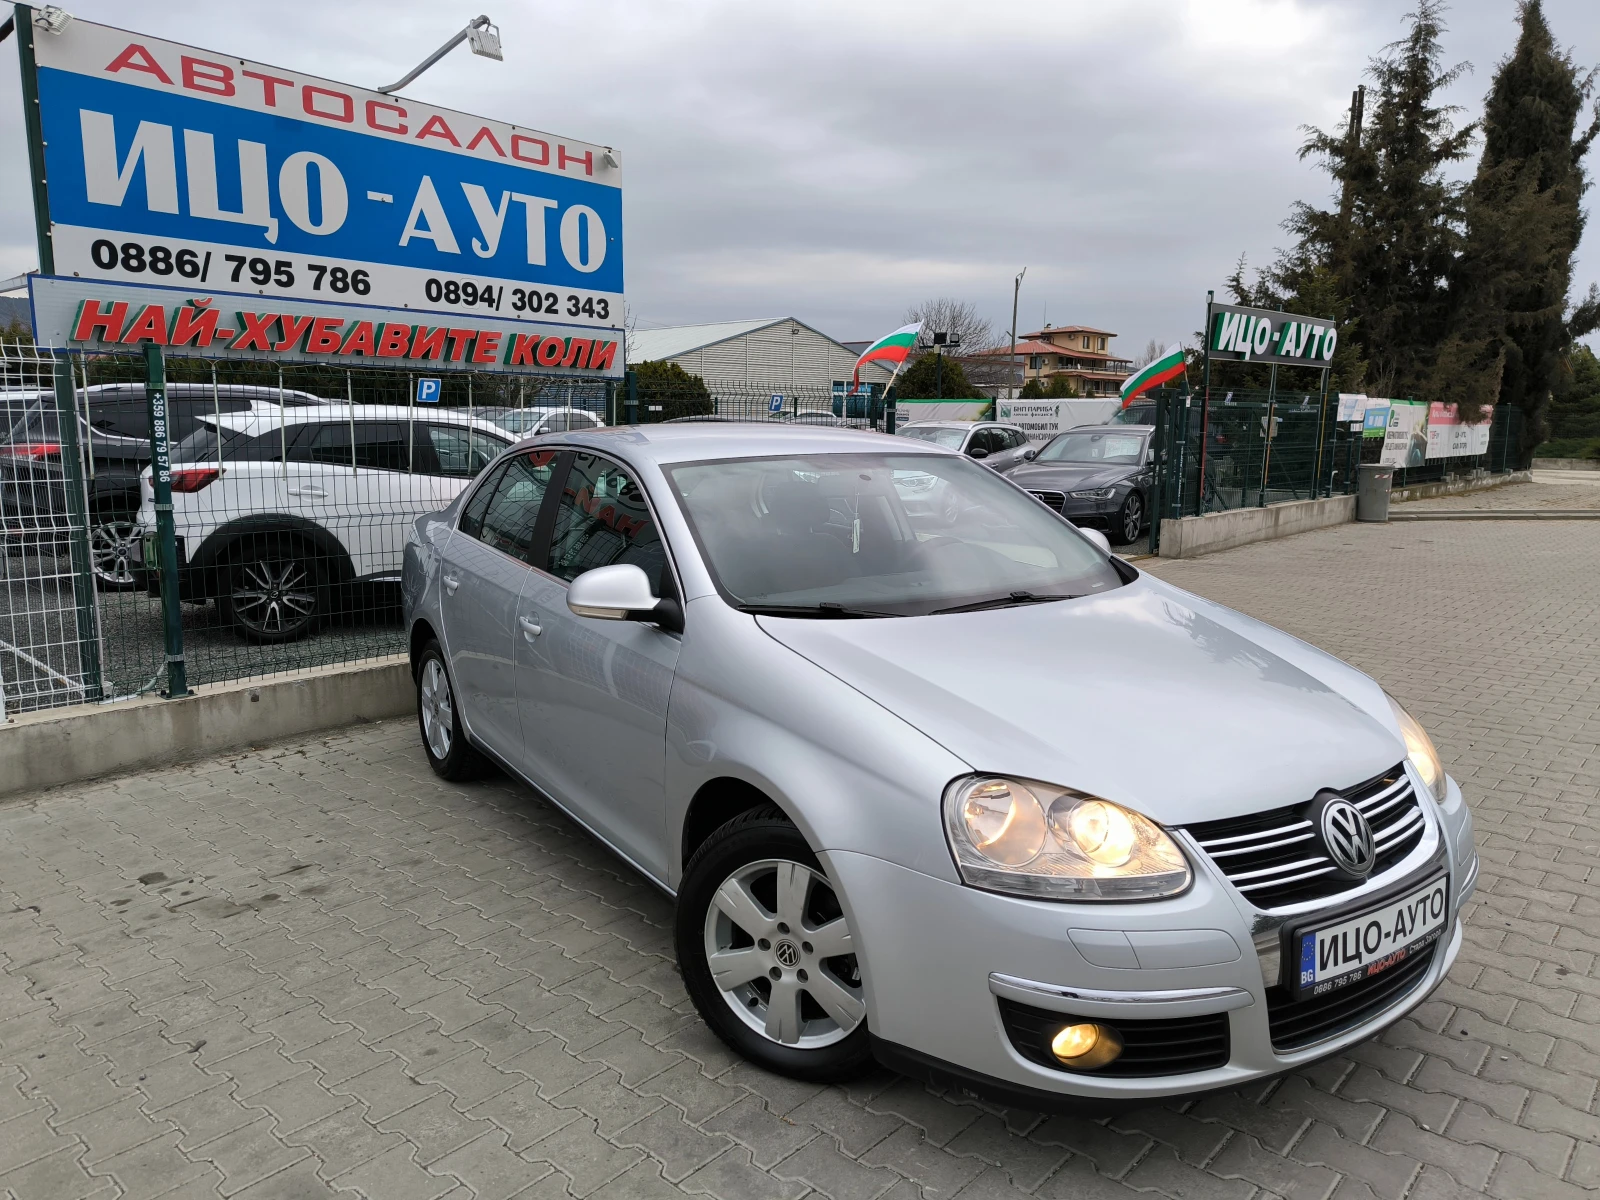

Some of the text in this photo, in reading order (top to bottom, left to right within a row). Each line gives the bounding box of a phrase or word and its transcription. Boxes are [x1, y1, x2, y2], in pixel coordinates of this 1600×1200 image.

[103, 42, 593, 177] АВТОСАЛОН
[90, 238, 372, 297] 0886/ 795 786
[424, 277, 611, 320] 0894/ 302 343
[72, 297, 618, 370] НАЙ-ХУБАВИТЕ КОЛИ
[1215, 311, 1338, 361] ИЦО-АУТО
[421, 381, 436, 399] P
[152, 392, 171, 483] +359 886 79 57 86
[1319, 887, 1444, 972] ИЦО-АУТО
[1300, 968, 1314, 985] BG
[1334, 975, 1348, 989] 795
[1348, 970, 1362, 983] 786
